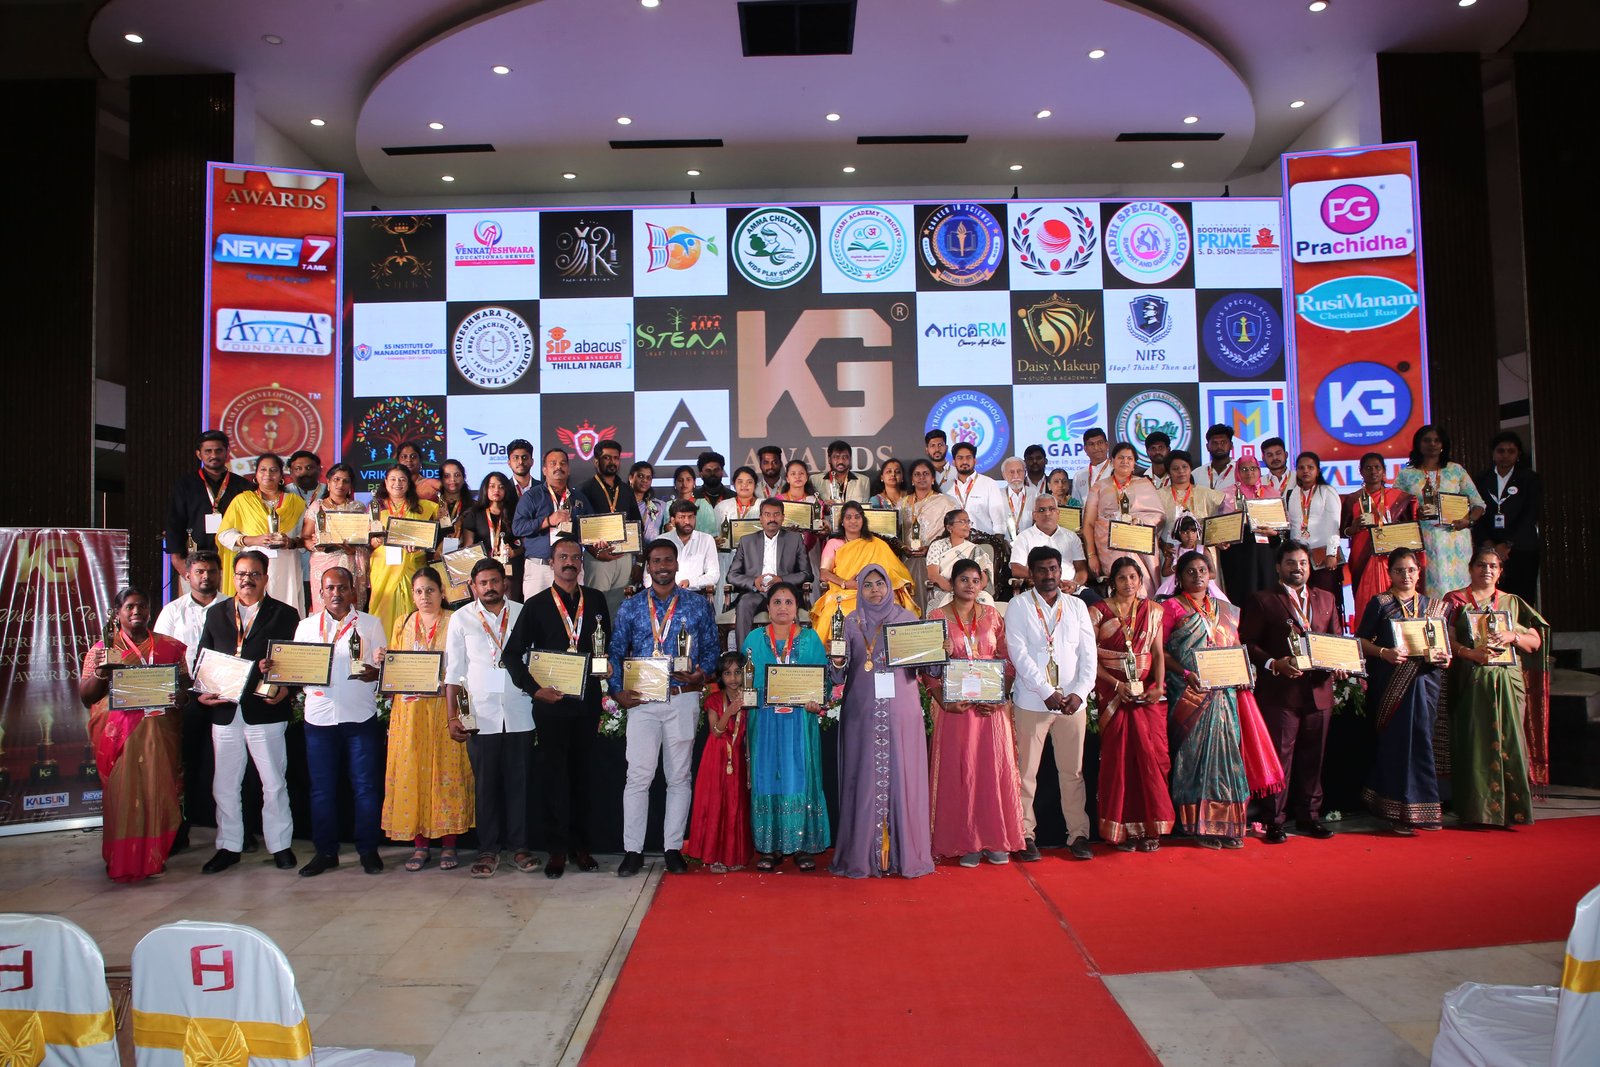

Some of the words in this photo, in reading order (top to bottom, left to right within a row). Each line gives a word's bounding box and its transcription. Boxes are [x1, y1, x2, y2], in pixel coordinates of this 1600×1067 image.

[225, 188, 327, 210] AWARDS
[965, 204, 993, 227] SCIENCE
[1328, 196, 1371, 223] PG
[746, 216, 768, 234] AMMA
[769, 215, 803, 234] CHELLAM
[849, 209, 881, 221] ACADEMY
[883, 215, 902, 237] TRICHY
[1116, 202, 1169, 223] SPECIAL
[1169, 215, 1187, 267] SCHOOL
[1198, 234, 1251, 248] PRIME
[222, 239, 296, 261] NEWS
[308, 239, 331, 263] 7
[1297, 235, 1408, 257] Prachidha
[748, 261, 761, 273] KIDS
[762, 269, 778, 277] PLAY
[779, 261, 803, 276] SCHOOL
[1138, 260, 1153, 268] AND
[1297, 292, 1418, 312] RusiManam
[505, 312, 525, 329] LAW
[1223, 299, 1257, 311] SPECIAL
[1258, 306, 1272, 340] SCHOOL
[1319, 310, 1368, 320] Chettinad
[1375, 308, 1398, 317] Rusi
[223, 310, 324, 345] AYYAA
[455, 309, 502, 361] VIGNESHWARA
[474, 322, 509, 335] COACHING
[509, 331, 520, 352] CLASS
[222, 342, 324, 354] FOUNDATIONS
[574, 339, 622, 353] abacus
[512, 333, 532, 379] ACADEMY
[1136, 349, 1166, 361] NIFS
[461, 364, 475, 379] SRI
[552, 362, 586, 370] THILLAI
[590, 361, 622, 369] NAGAR
[737, 309, 894, 438] KG
[1018, 360, 1050, 374] Daisy
[1053, 360, 1100, 374] Makeup
[1161, 363, 1180, 371] Then
[480, 377, 507, 385] SVLA
[247, 391, 303, 407] DEVELOPMENT
[308, 392, 321, 400] TM
[1141, 393, 1151, 401] OF
[1329, 379, 1396, 428] KG
[932, 402, 948, 427] TRICHY
[948, 393, 978, 405] SPECIAL
[979, 398, 1001, 424] SCHOOL
[479, 442, 508, 455] VDa
[17, 538, 79, 583] KG
[75, 604, 97, 621] To
[25, 795, 65, 807] KALSUN
